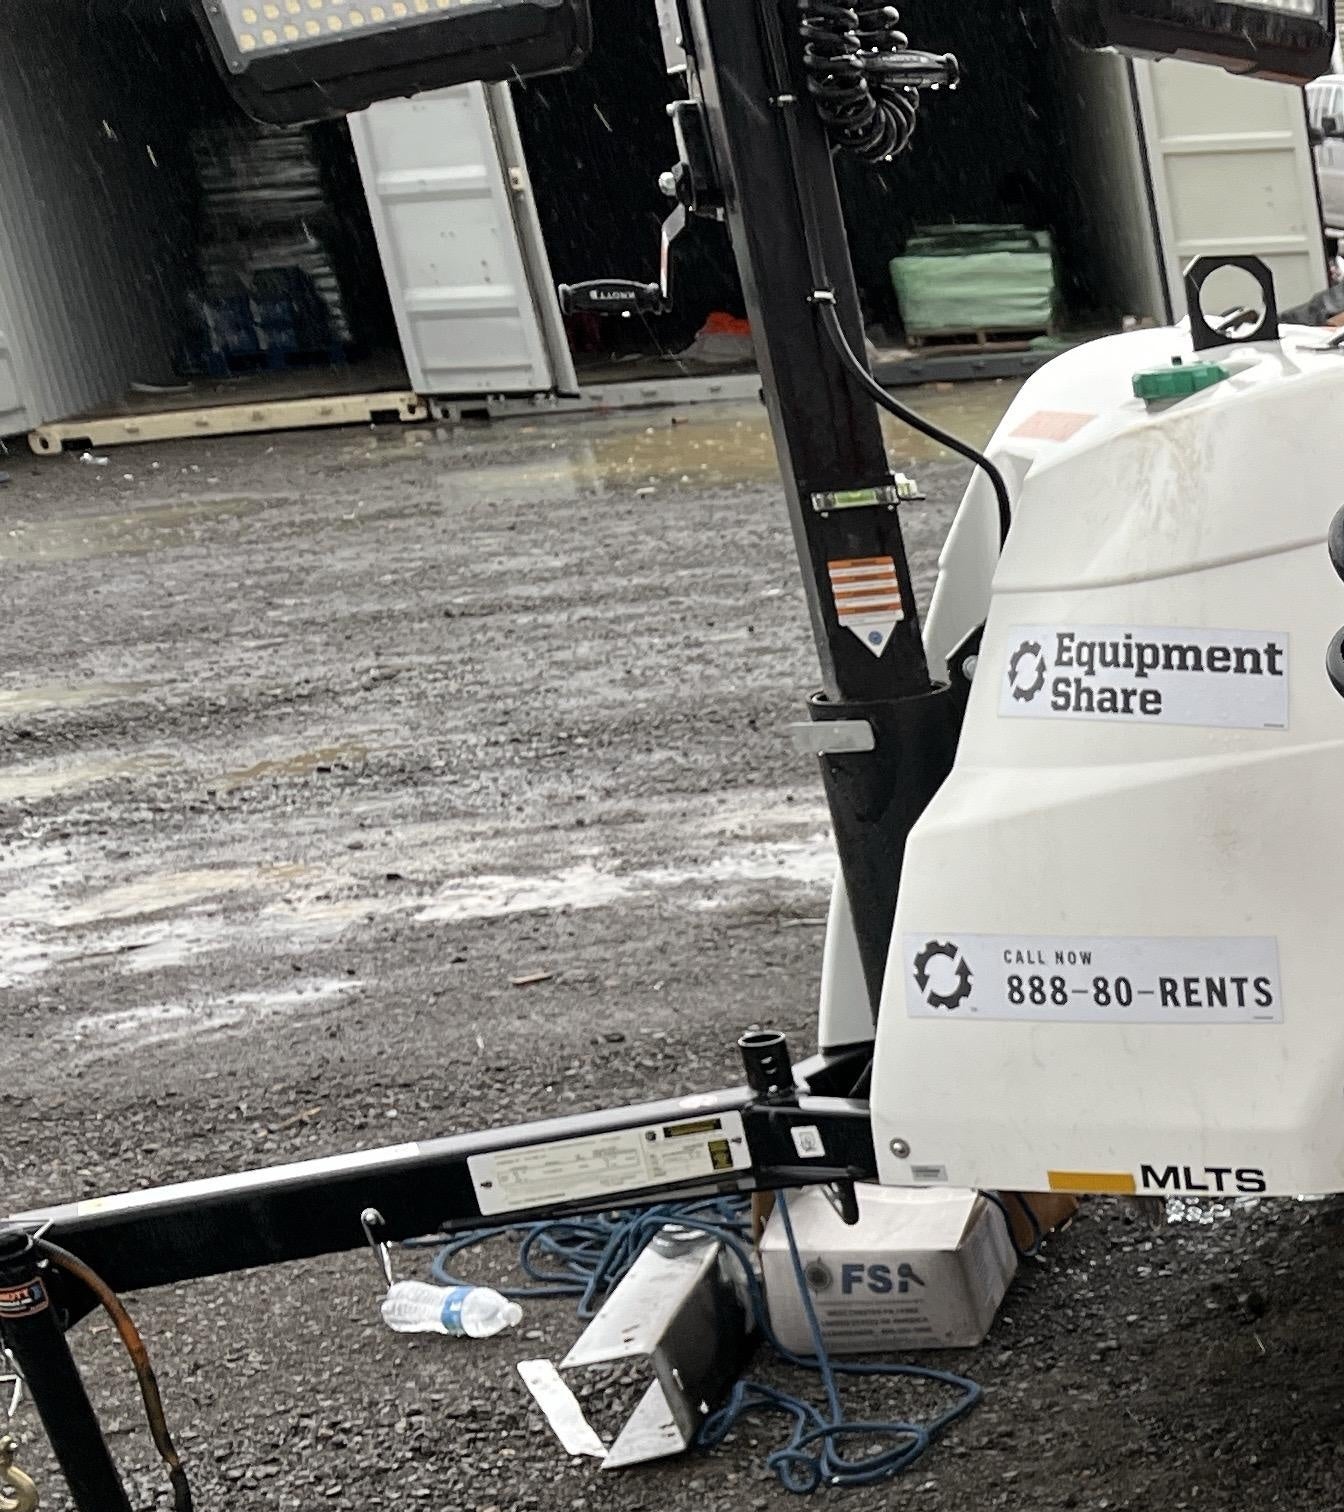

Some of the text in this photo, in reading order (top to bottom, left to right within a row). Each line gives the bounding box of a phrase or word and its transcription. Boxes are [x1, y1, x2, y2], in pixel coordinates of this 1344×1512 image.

[1053, 631, 1284, 678] Equipment
[1050, 676, 1163, 716] Share
[1003, 949, 1093, 966] CALL NOW
[1006, 974, 1274, 1008] 888-80-RENTS
[1140, 1163, 1267, 1193] MLTS
